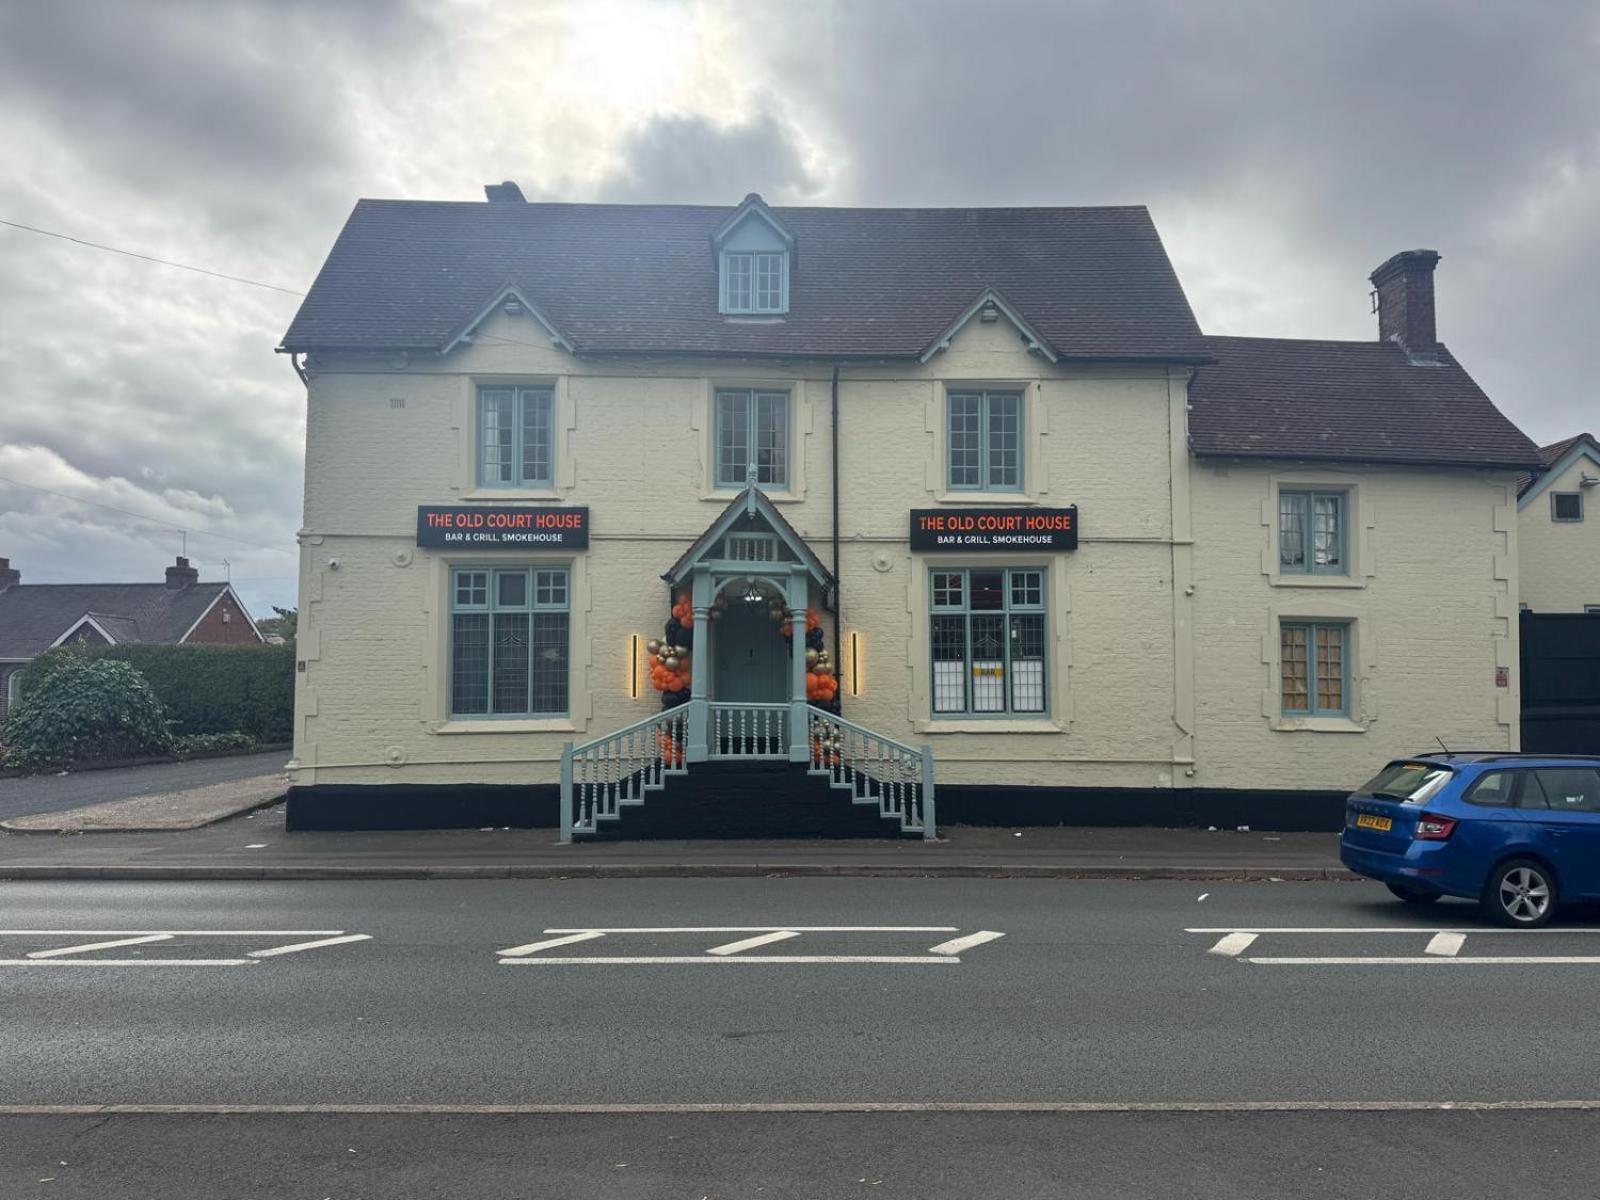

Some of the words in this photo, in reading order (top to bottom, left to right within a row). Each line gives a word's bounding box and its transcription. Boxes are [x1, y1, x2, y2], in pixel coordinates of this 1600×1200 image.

[427, 514, 452, 527] THE
[456, 514, 483, 527] OLD
[487, 514, 532, 528] COURT
[536, 515, 581, 528] HOUSE
[920, 517, 944, 530] THE
[948, 516, 974, 530] OLD
[978, 516, 1022, 529] COURT
[1026, 516, 1070, 529] HOUSE
[445, 533, 462, 541] BAR
[465, 533, 471, 541] &
[473, 534, 499, 542] GRILL,
[502, 534, 562, 542] SMOKEHOUSE
[965, 536, 990, 544] GRILL,
